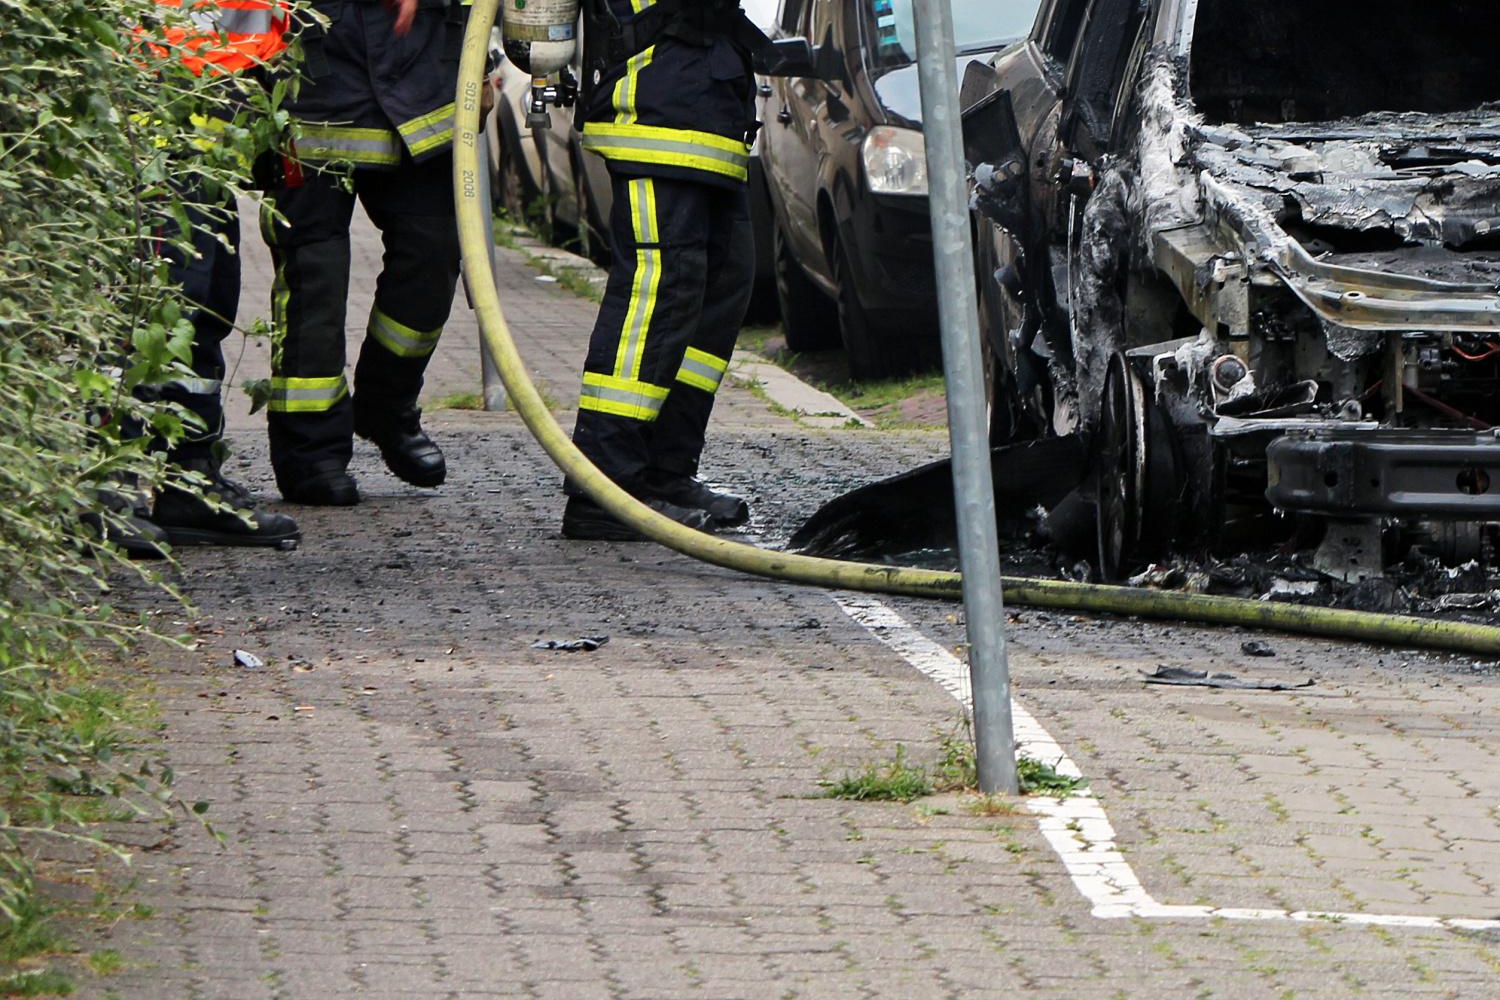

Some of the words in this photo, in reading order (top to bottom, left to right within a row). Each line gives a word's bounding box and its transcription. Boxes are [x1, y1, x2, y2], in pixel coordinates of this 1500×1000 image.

[464, 81, 477, 112] SDIS
[462, 132, 474, 148] 67
[463, 170, 475, 198] 2008
